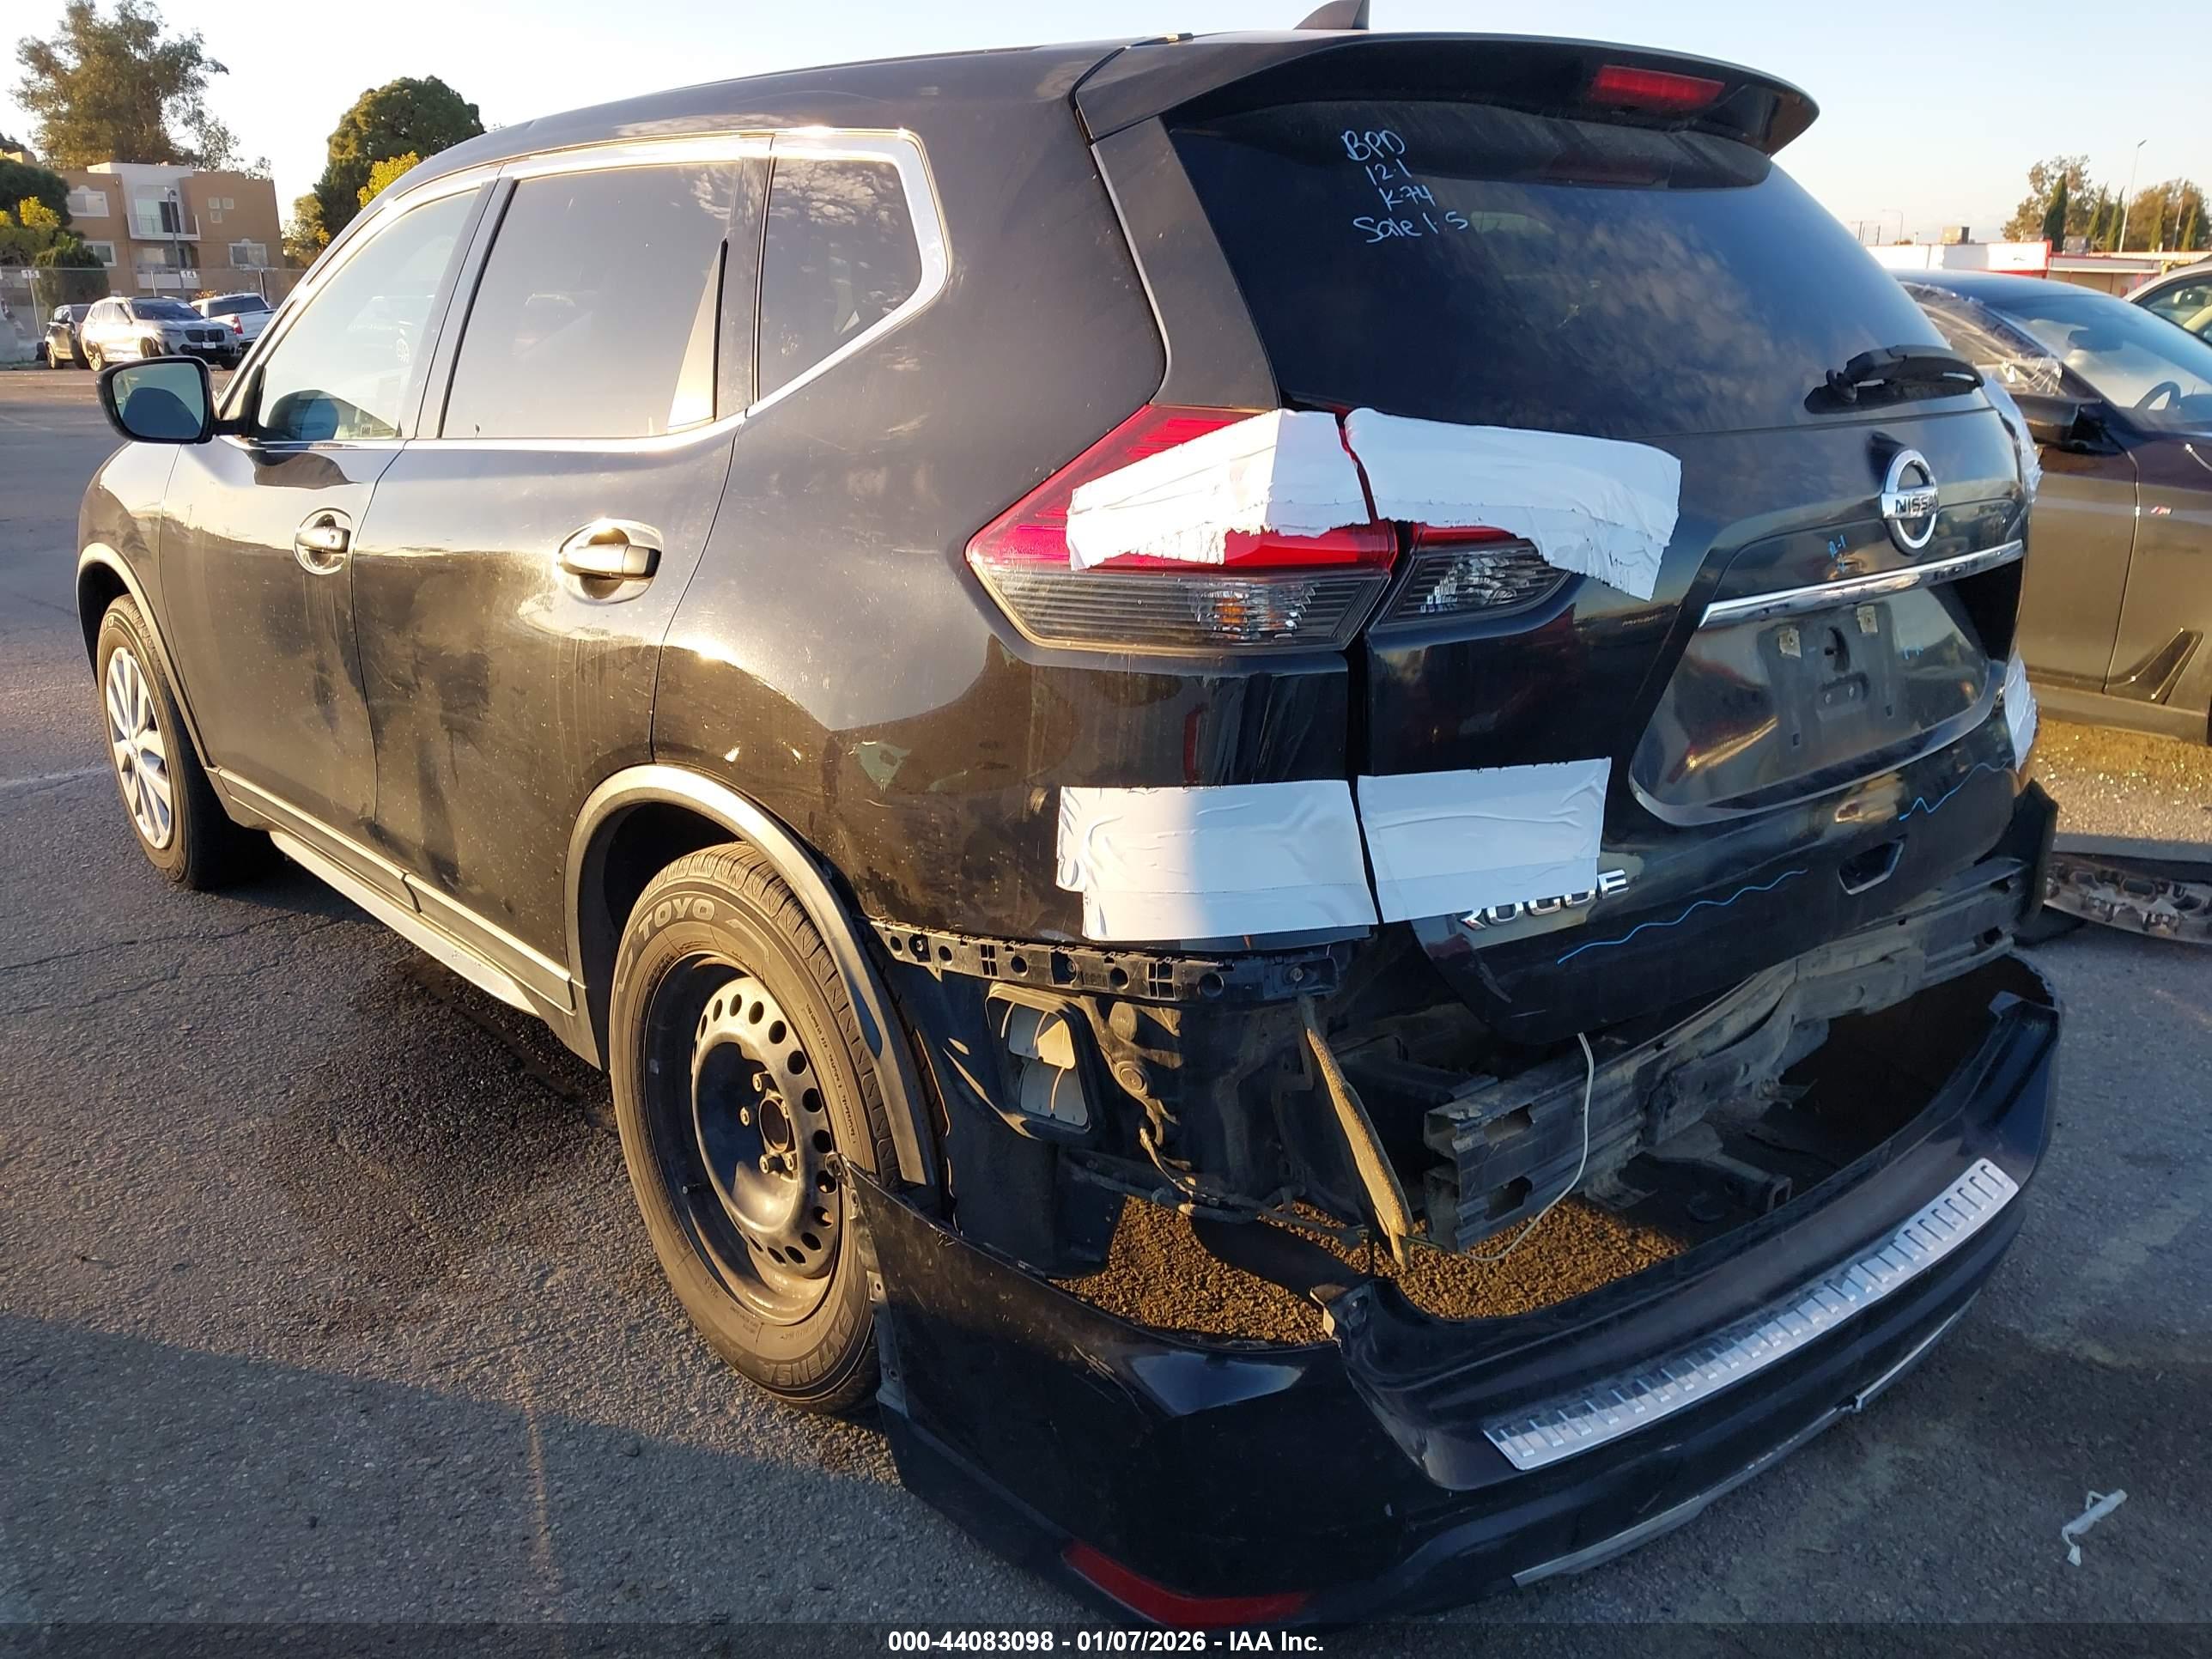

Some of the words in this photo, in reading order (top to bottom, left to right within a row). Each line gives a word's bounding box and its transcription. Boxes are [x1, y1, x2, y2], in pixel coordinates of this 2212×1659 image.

[1353, 216, 1422, 243] Sale
[638, 896, 715, 942] TOYO
[756, 1298, 856, 1387] EXTENSA
